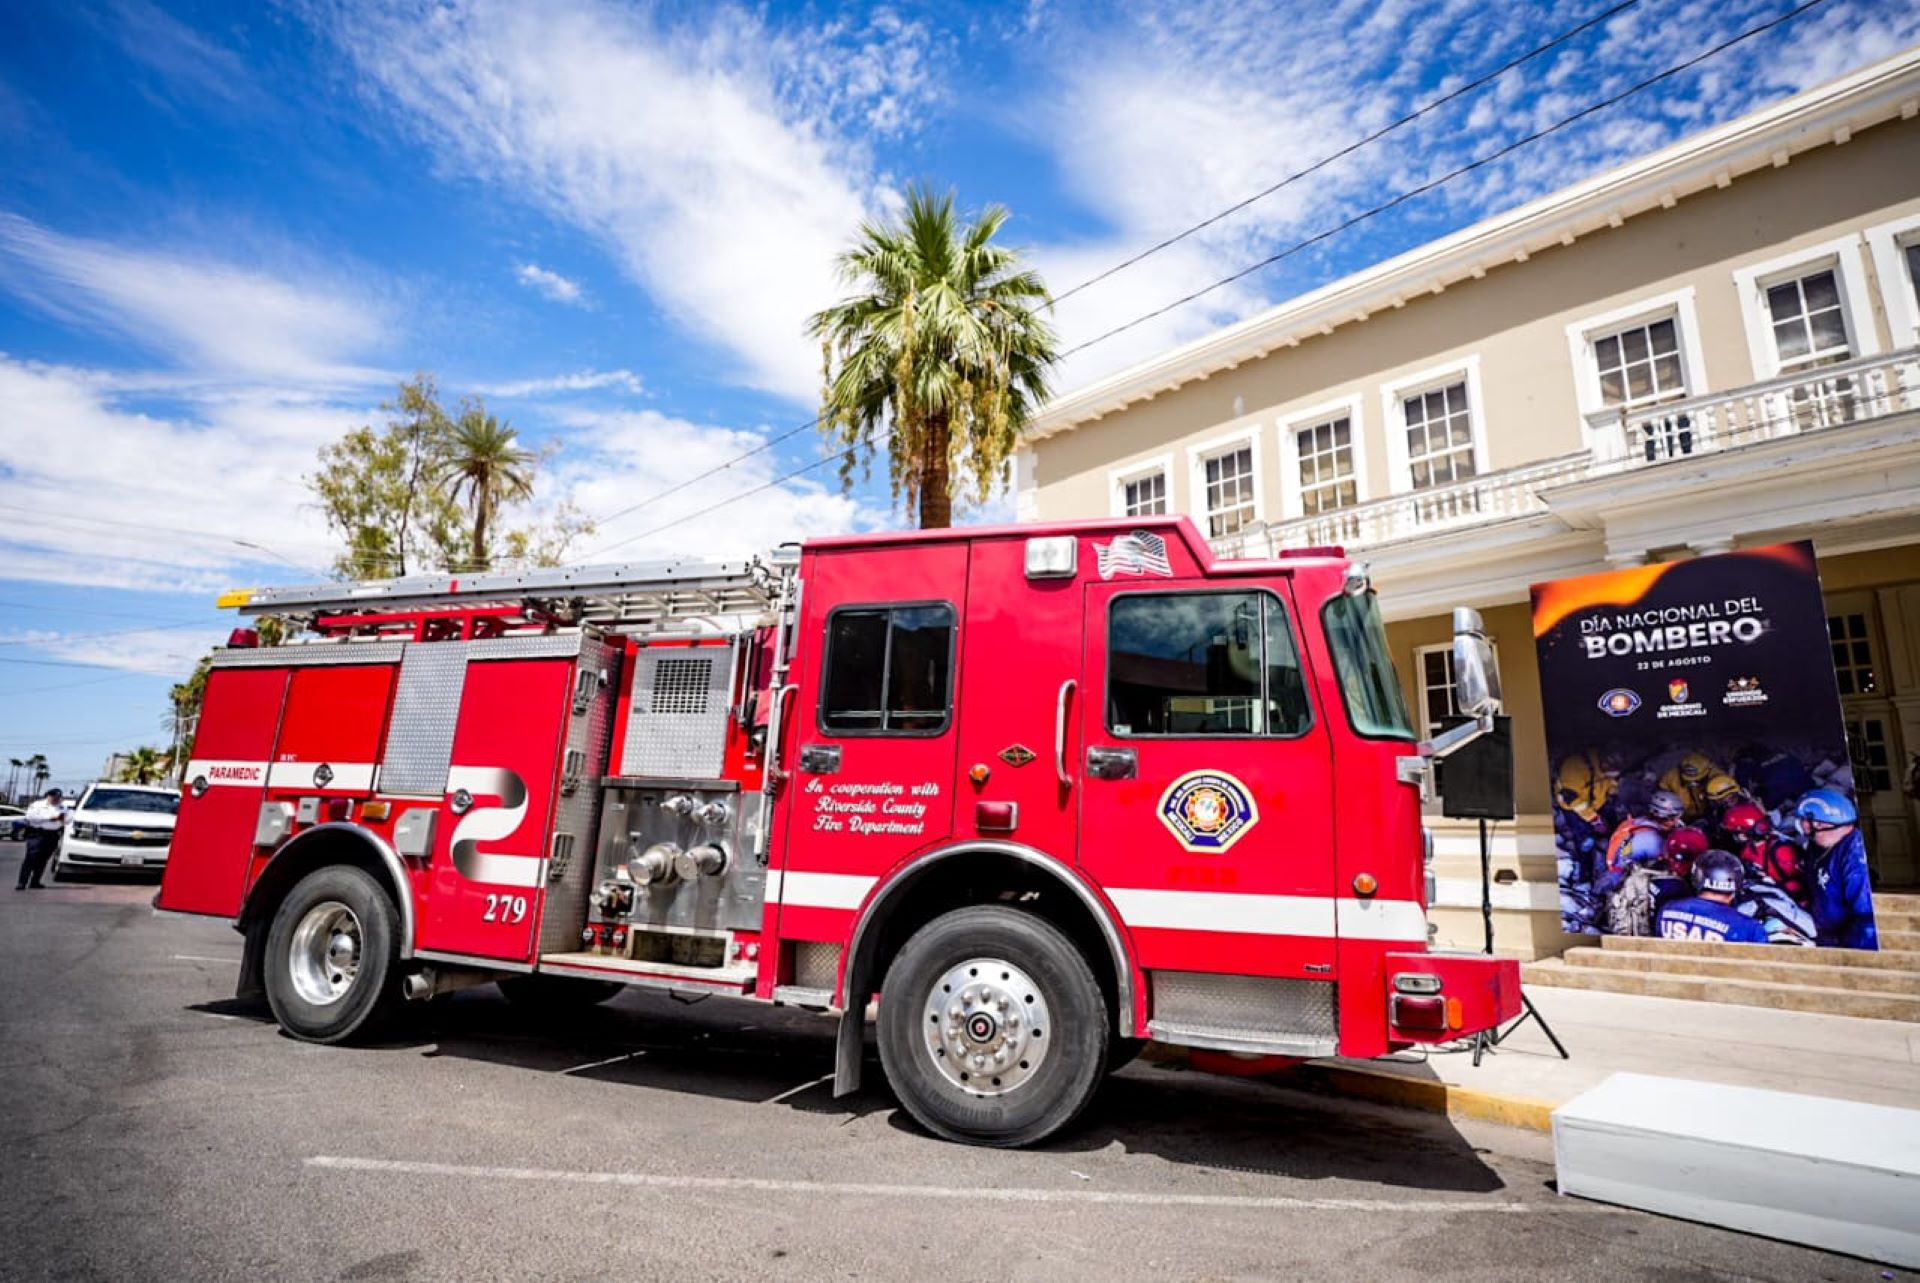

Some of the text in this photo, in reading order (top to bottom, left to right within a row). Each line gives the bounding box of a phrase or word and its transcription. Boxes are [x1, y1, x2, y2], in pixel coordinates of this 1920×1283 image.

[1580, 597, 1763, 633] DÍA NACIONAL DEL
[1584, 617, 1763, 659] BOMBERO
[1637, 656, 1711, 670] 22 DE AGOSTO
[209, 766, 260, 780] PARAMEDIC
[805, 778, 939, 797] In cooperation with
[815, 796, 927, 818] Riverside County
[813, 815, 924, 835] Fire Department
[483, 893, 527, 924] 279
